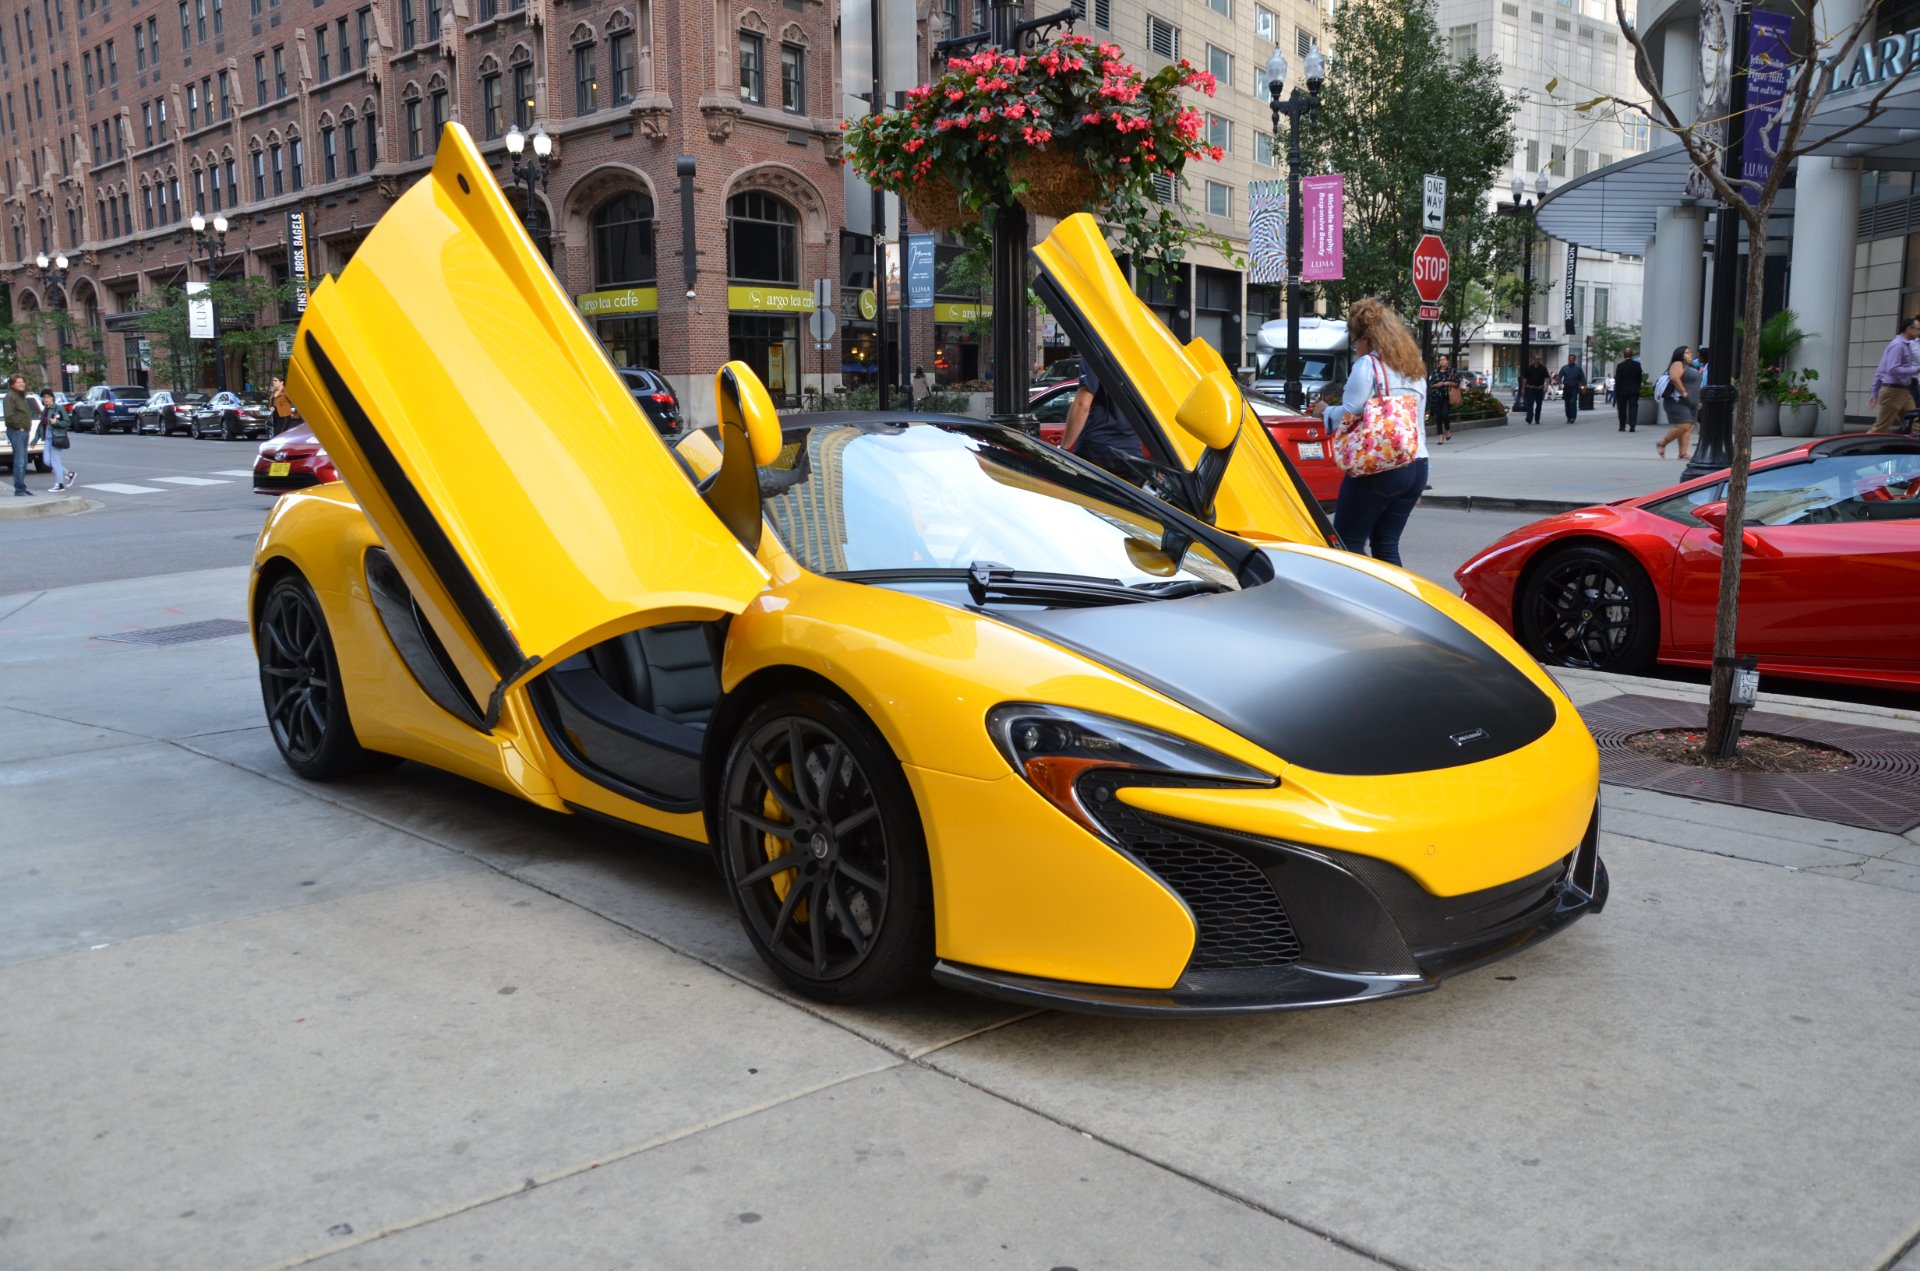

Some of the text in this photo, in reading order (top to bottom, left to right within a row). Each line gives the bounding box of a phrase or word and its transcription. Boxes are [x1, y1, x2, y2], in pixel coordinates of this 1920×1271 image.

[1744, 162, 1768, 178] LUMA
[1427, 180, 1443, 194] ONE
[1426, 195, 1443, 209] WAY
[291, 213, 303, 246] BAGELS
[1416, 256, 1446, 281] STOP
[1565, 247, 1575, 320] NORDSTROM rack
[600, 297, 611, 308] tea
[614, 290, 639, 308] café
[766, 295, 788, 309] argo
[790, 294, 801, 306] tea
[1421, 308, 1429, 317] ALL
[1538, 328, 1551, 339] rack
